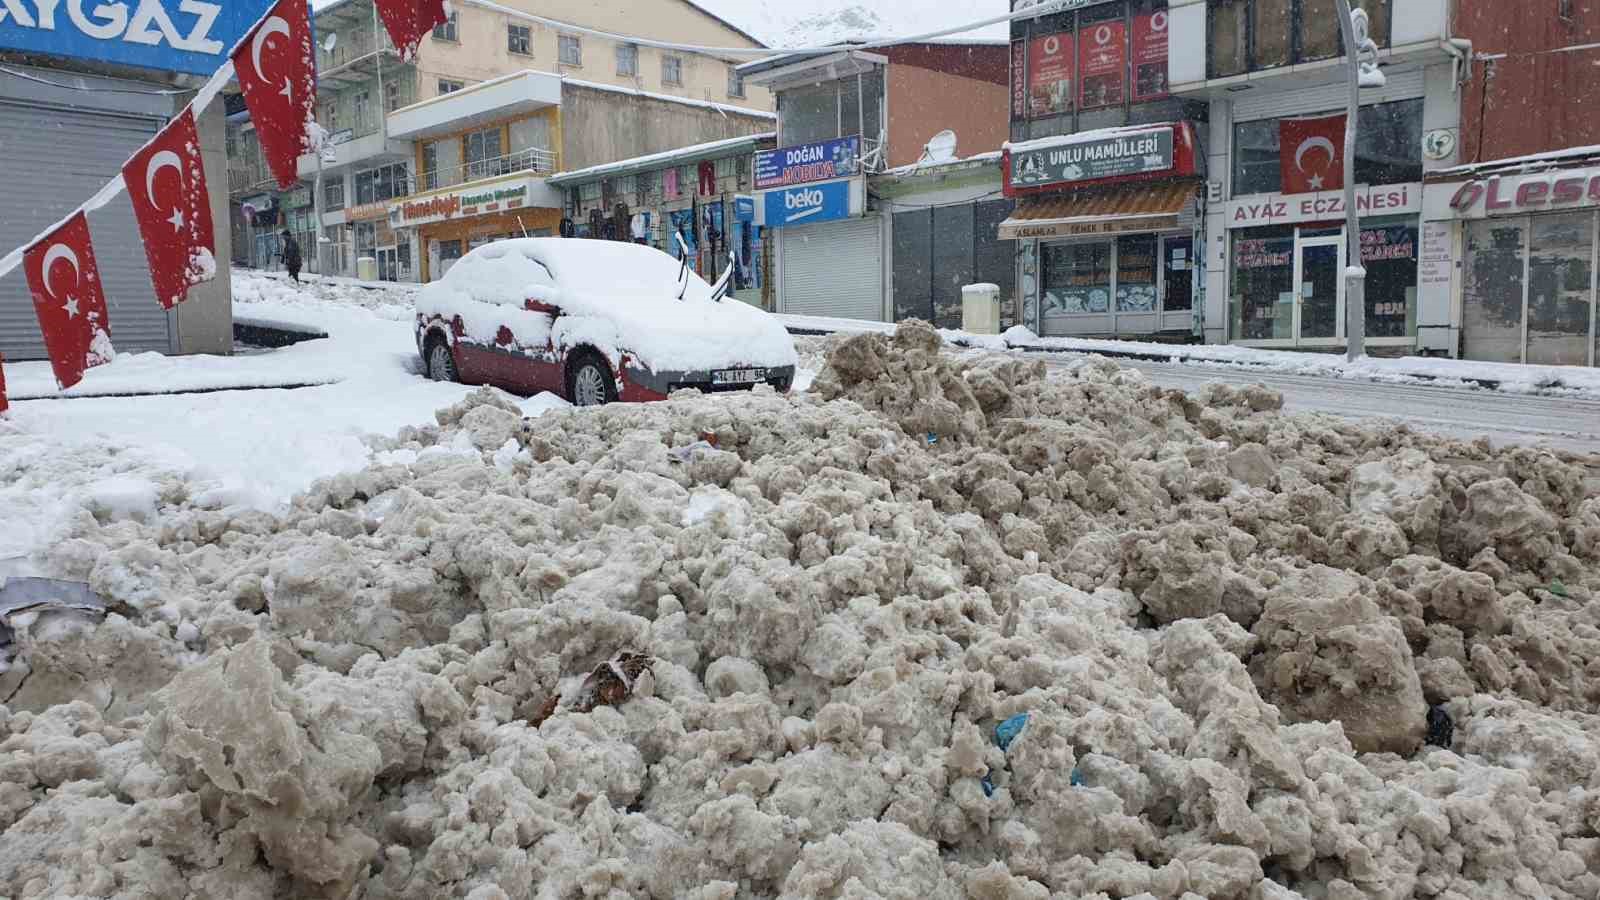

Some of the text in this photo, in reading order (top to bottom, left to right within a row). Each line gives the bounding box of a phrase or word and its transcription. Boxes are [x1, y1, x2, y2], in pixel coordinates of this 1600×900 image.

[786, 146, 824, 165] DOĞAN
[1050, 134, 1158, 165] UNLU MAMÜLLERİ
[785, 188, 824, 209] beko
[1234, 187, 1408, 221] AYAZ ECZNESİ
